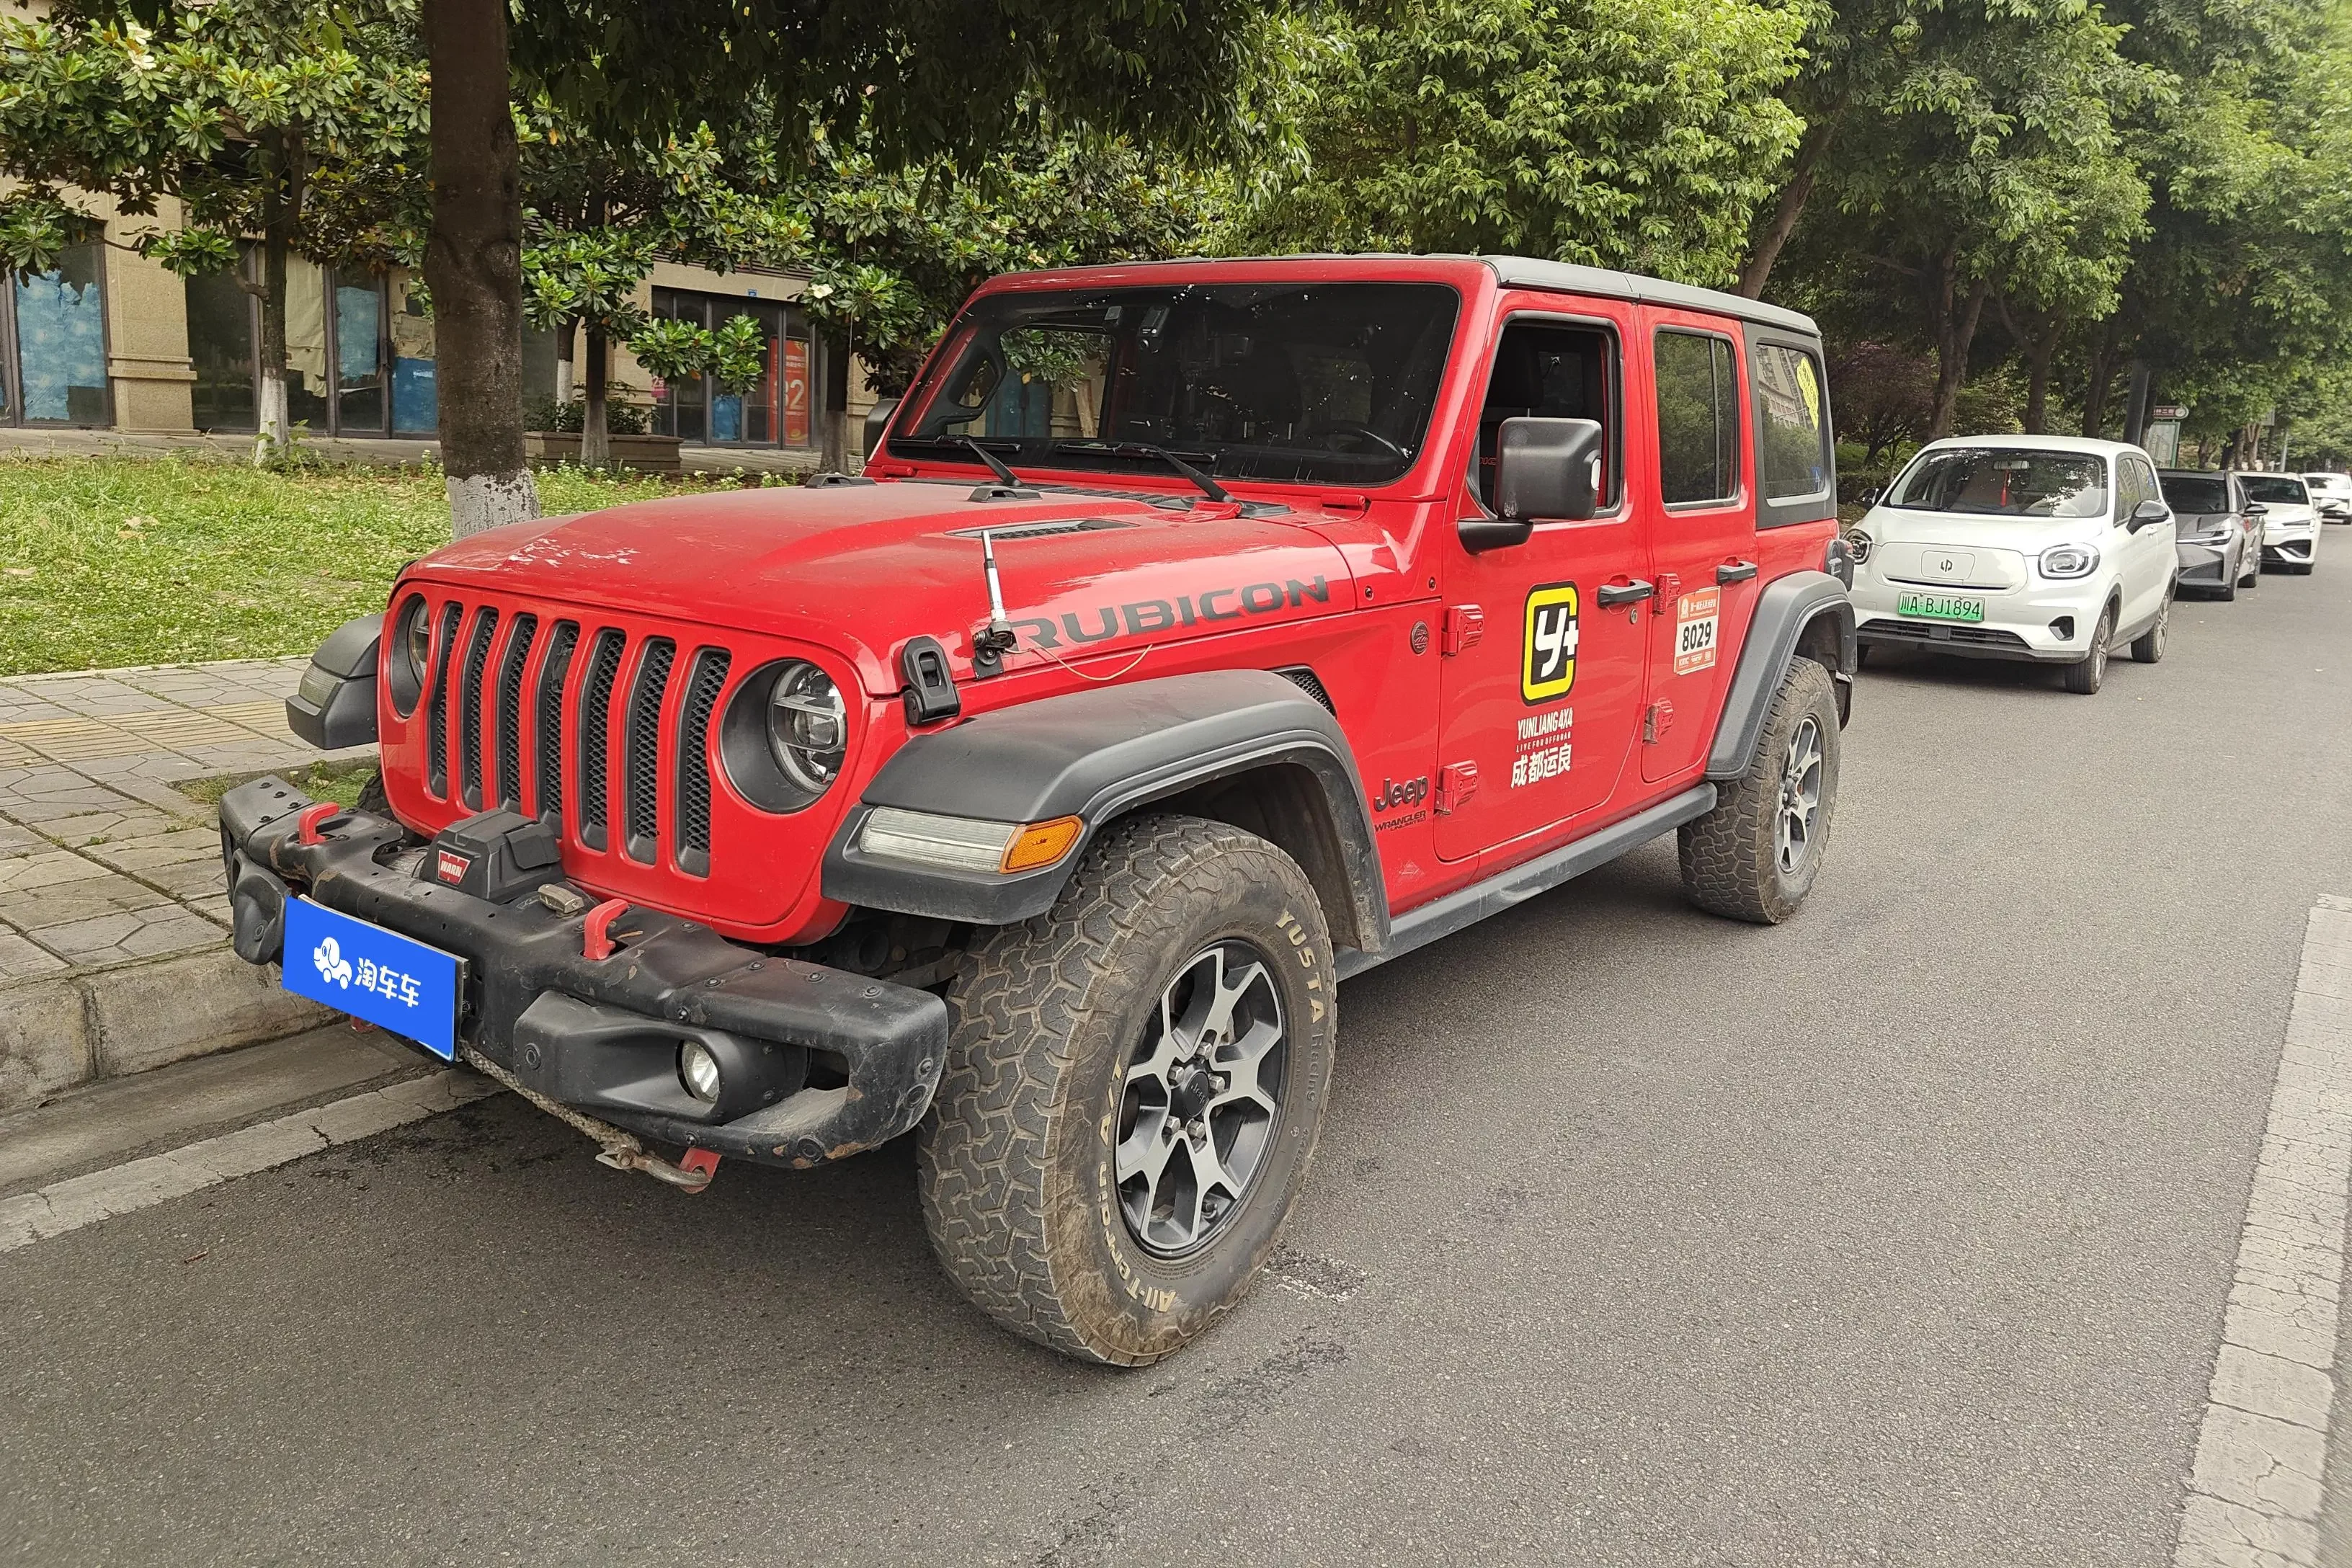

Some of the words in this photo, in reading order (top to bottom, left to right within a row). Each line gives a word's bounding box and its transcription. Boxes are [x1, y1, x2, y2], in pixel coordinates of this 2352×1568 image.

[1010, 575, 1329, 649] RUBICON
[1683, 621, 1711, 651] 8029
[1510, 742, 1572, 789] 成都运良
[1373, 775, 1428, 812] Jeep
[1374, 810, 1426, 832] WRANGLER
[440, 860, 463, 878] WARN
[1275, 909, 1325, 1024] YUSTA
